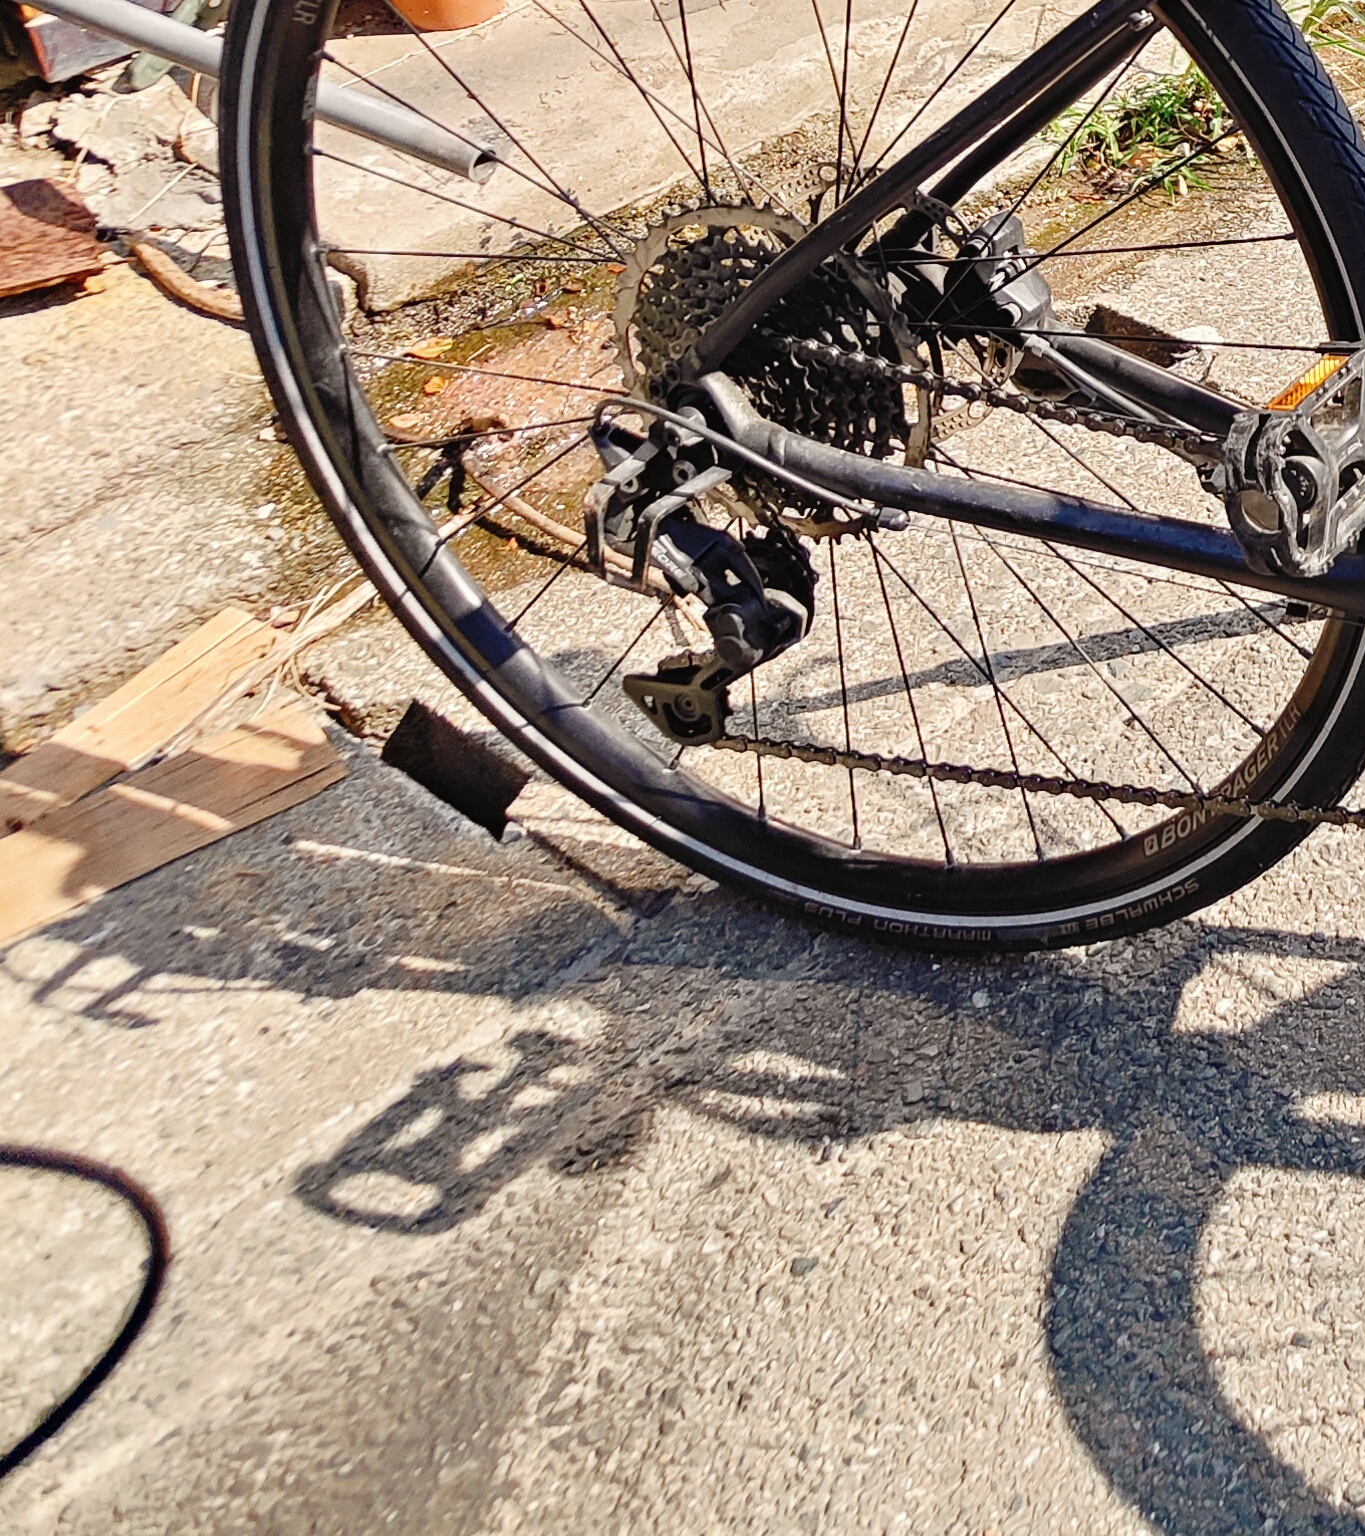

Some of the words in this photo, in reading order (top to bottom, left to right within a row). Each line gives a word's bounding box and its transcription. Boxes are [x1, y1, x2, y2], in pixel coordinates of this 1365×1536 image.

[1278, 701, 1301, 738] TLR
[804, 902, 861, 926] PLUS
[1085, 876, 1200, 930] SCHWALBE
[874, 918, 991, 942] MARATHON
